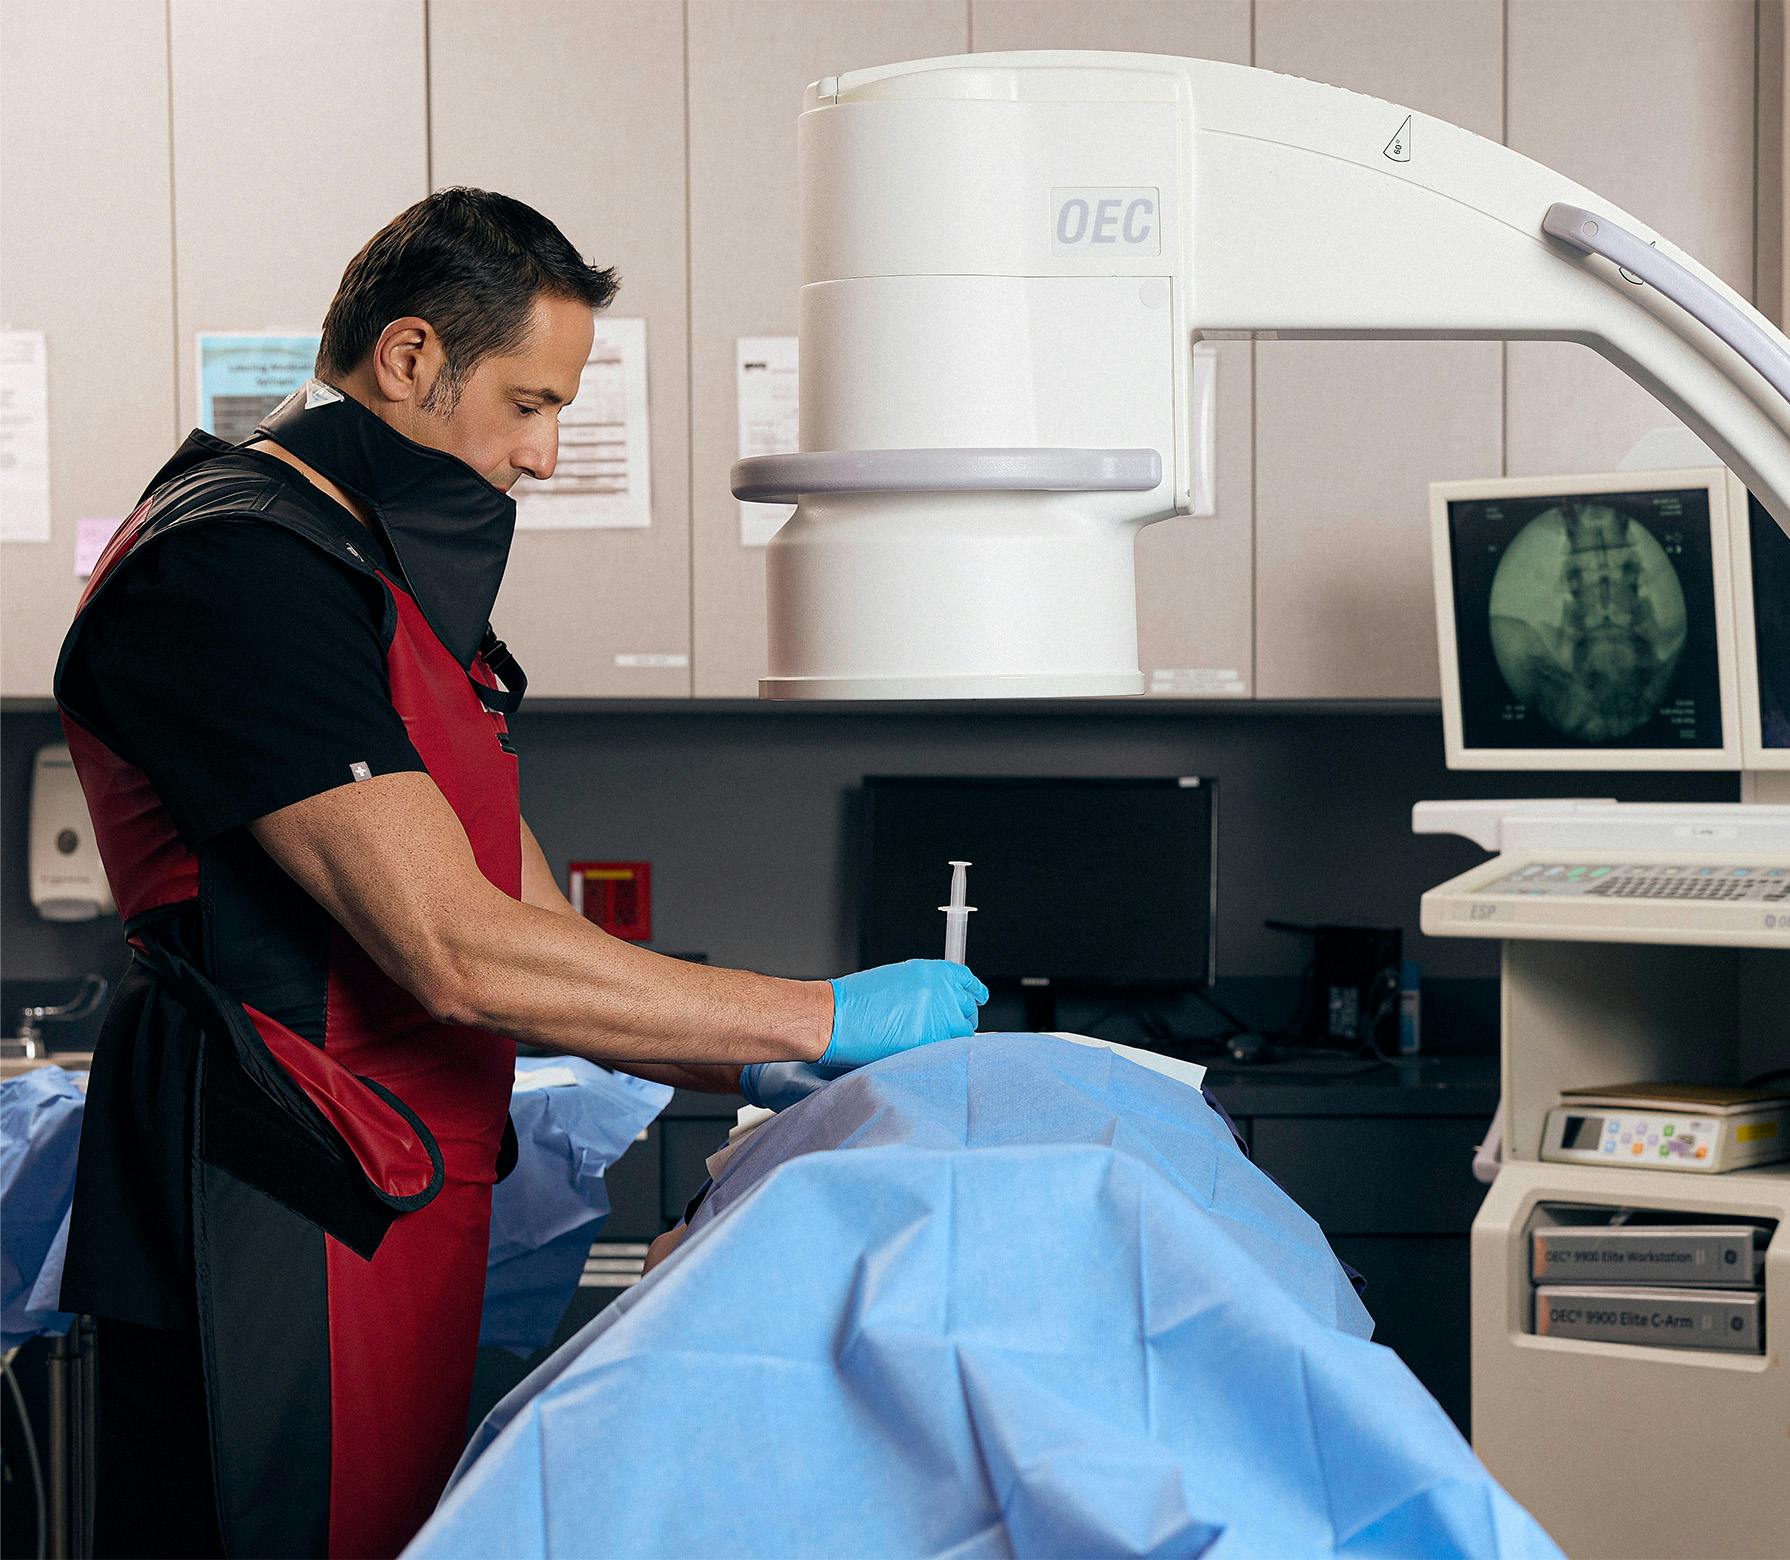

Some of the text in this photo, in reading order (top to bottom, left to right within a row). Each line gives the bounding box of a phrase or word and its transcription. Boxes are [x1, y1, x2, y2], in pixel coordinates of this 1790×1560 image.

[1056, 198, 1154, 244] OEC
[1471, 903, 1497, 920] ESP
[1574, 1250, 1600, 1263] 9900
[1602, 1250, 1624, 1263] Elite
[1627, 1250, 1693, 1264] Workstation
[1585, 1310, 1617, 1325] 9900
[1619, 1311, 1647, 1327] Elite
[1651, 1312, 1693, 1329] C-Arm
